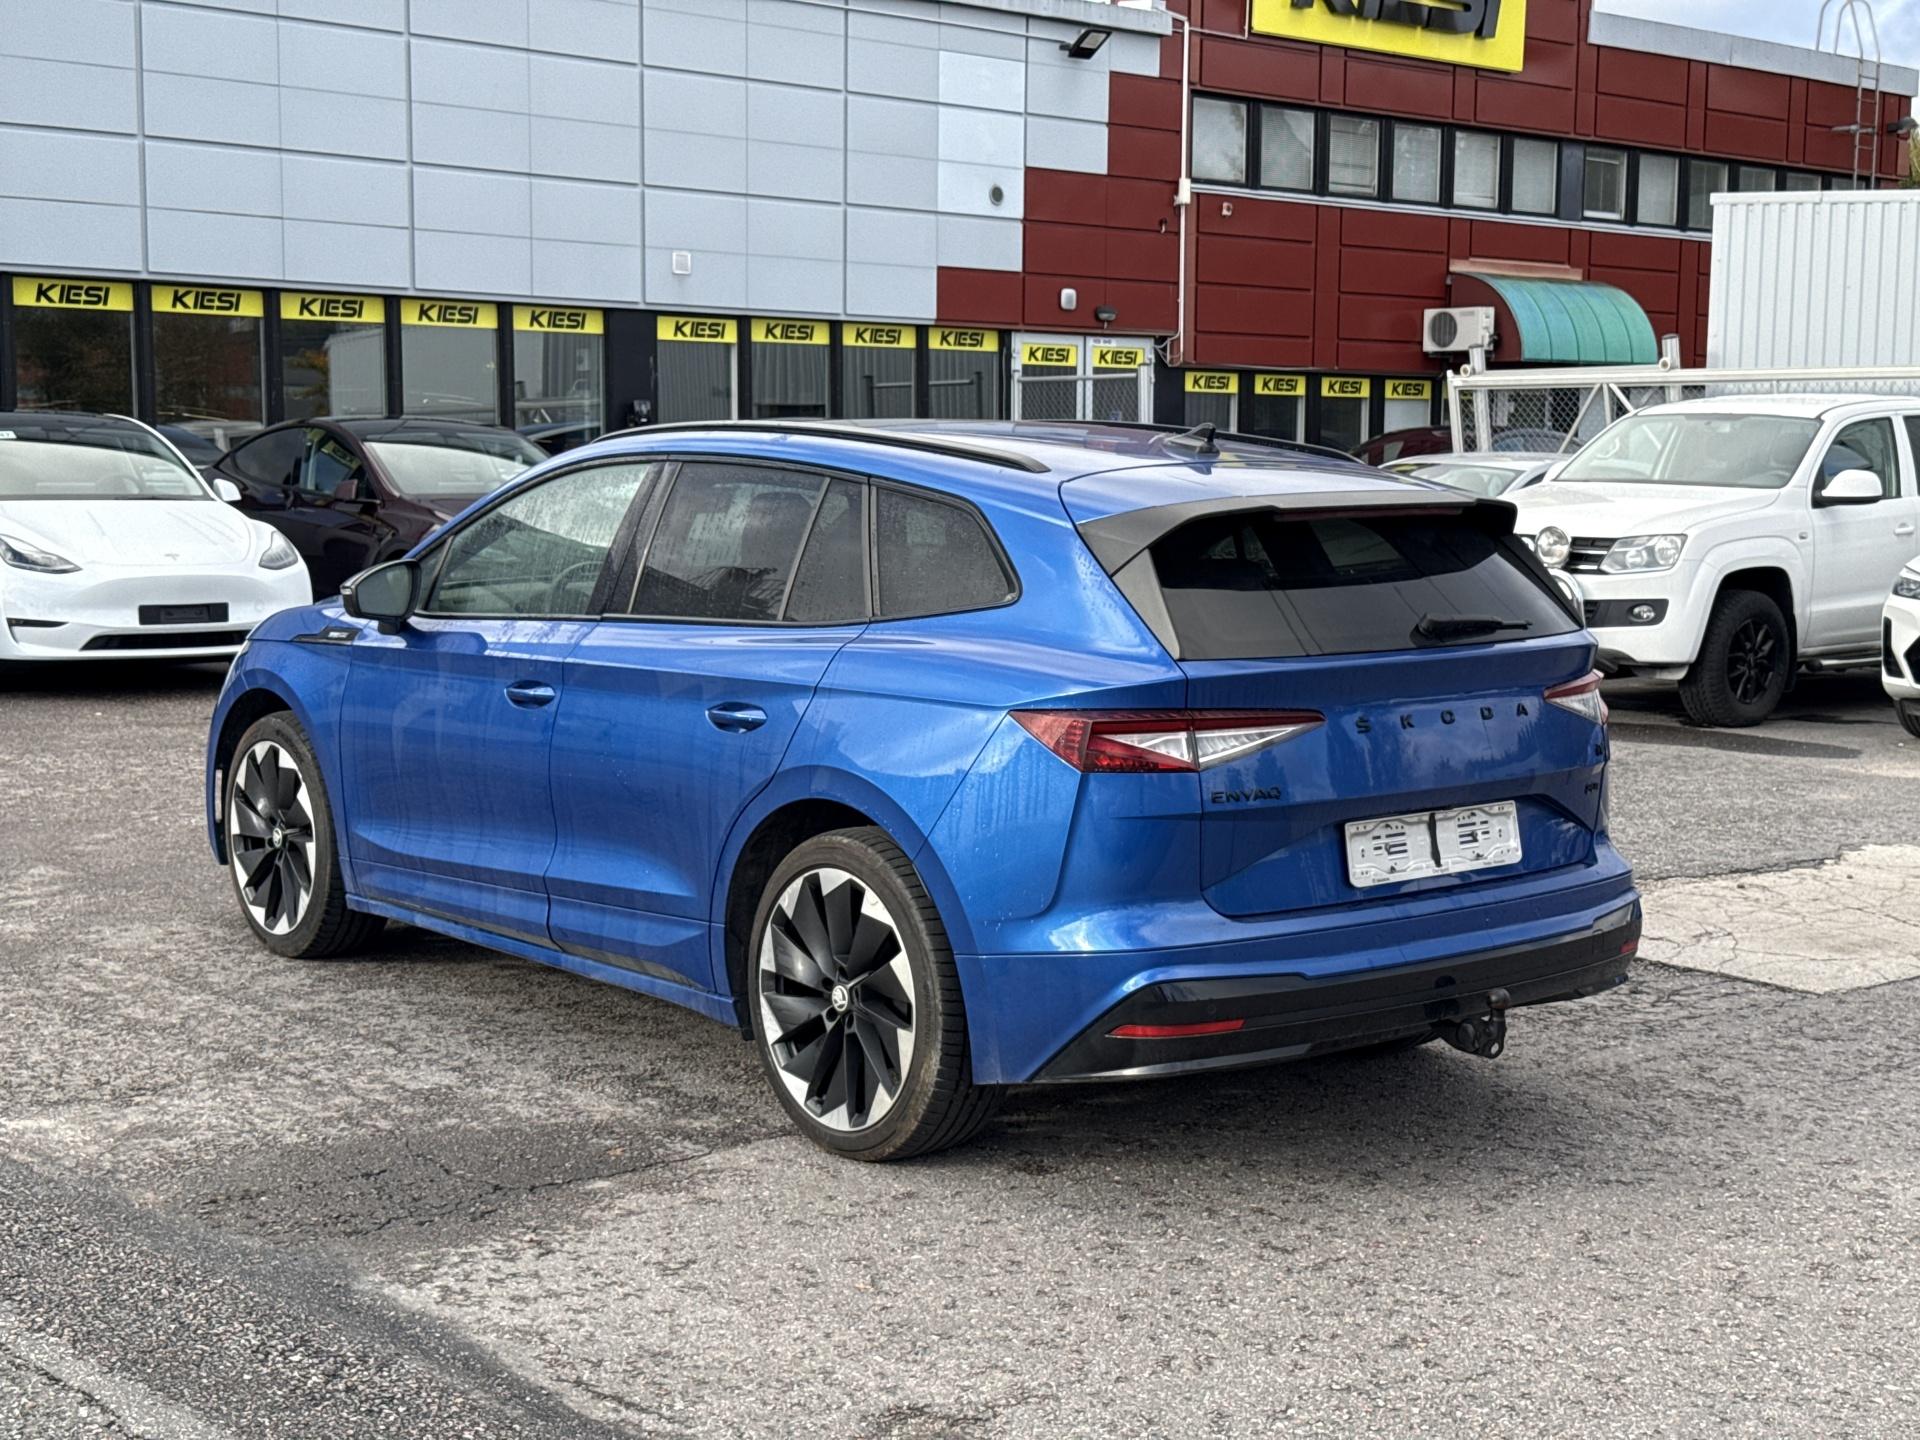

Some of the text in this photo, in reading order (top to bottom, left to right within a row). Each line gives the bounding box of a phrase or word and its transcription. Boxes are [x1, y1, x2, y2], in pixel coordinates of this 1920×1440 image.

[36, 282, 111, 306] KIESI
[171, 289, 242, 312] KIESI
[299, 296, 365, 319] KIESI
[418, 302, 480, 324] KIESI
[529, 309, 585, 329] KIESI
[674, 320, 726, 340] KIESI
[764, 322, 815, 342] KIESI
[854, 327, 902, 346] KIESI
[939, 330, 985, 348] KIESI
[1028, 347, 1071, 363] KIESI
[1098, 350, 1138, 365] KIESI
[1192, 374, 1231, 389] KIESI
[1261, 377, 1299, 393] KIESI
[1327, 379, 1363, 395] KIESI
[1391, 382, 1426, 397] KIESI
[1210, 785, 1281, 804] ENYAQ
